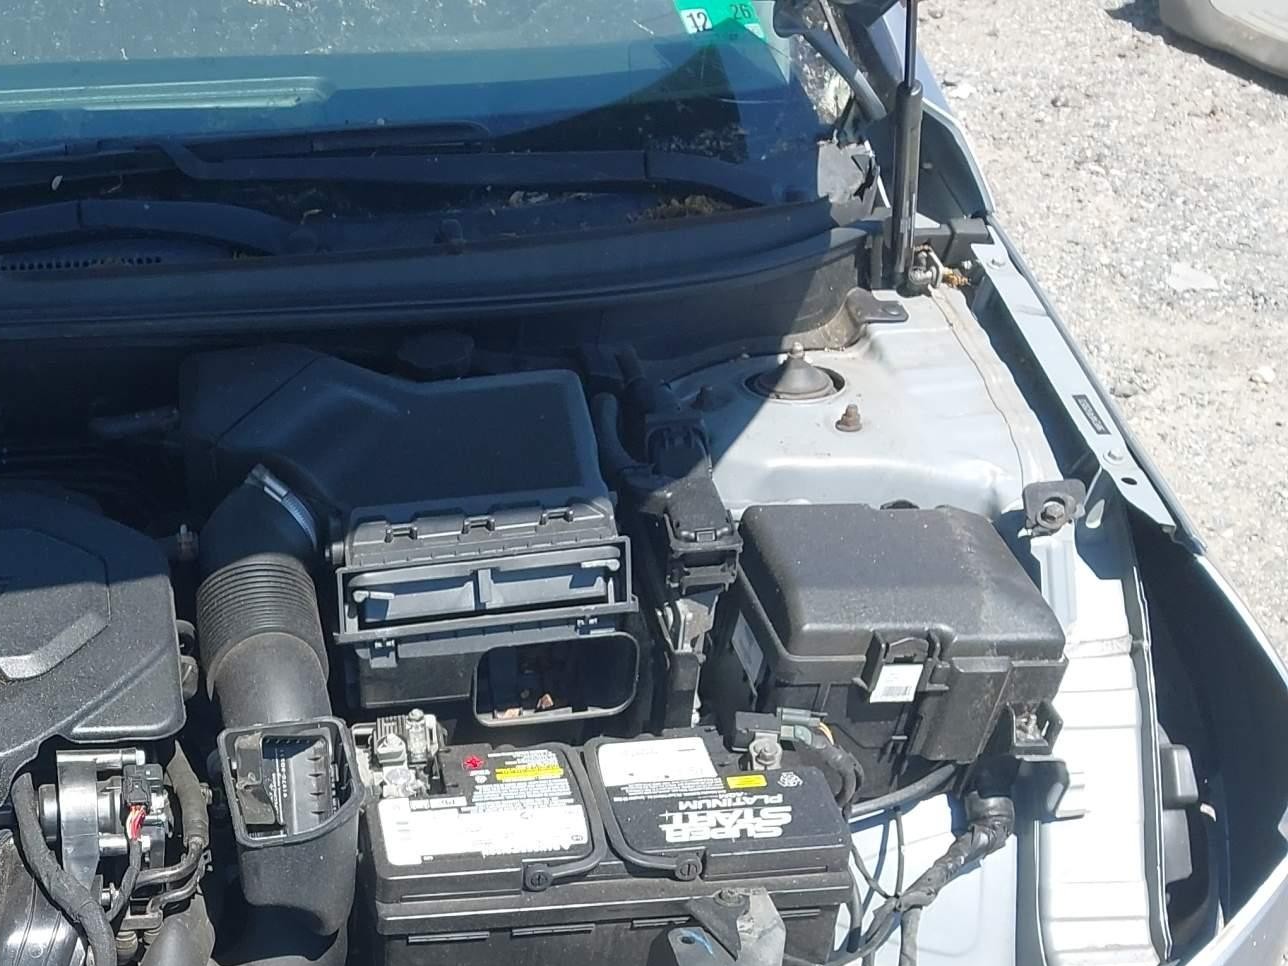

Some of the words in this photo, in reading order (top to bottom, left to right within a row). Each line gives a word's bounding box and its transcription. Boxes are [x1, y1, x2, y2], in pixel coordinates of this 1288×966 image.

[731, 4, 752, 19] 26
[679, 794, 783, 810] PLATINUM
[661, 806, 793, 829] START
[660, 824, 783, 843] SUPER
